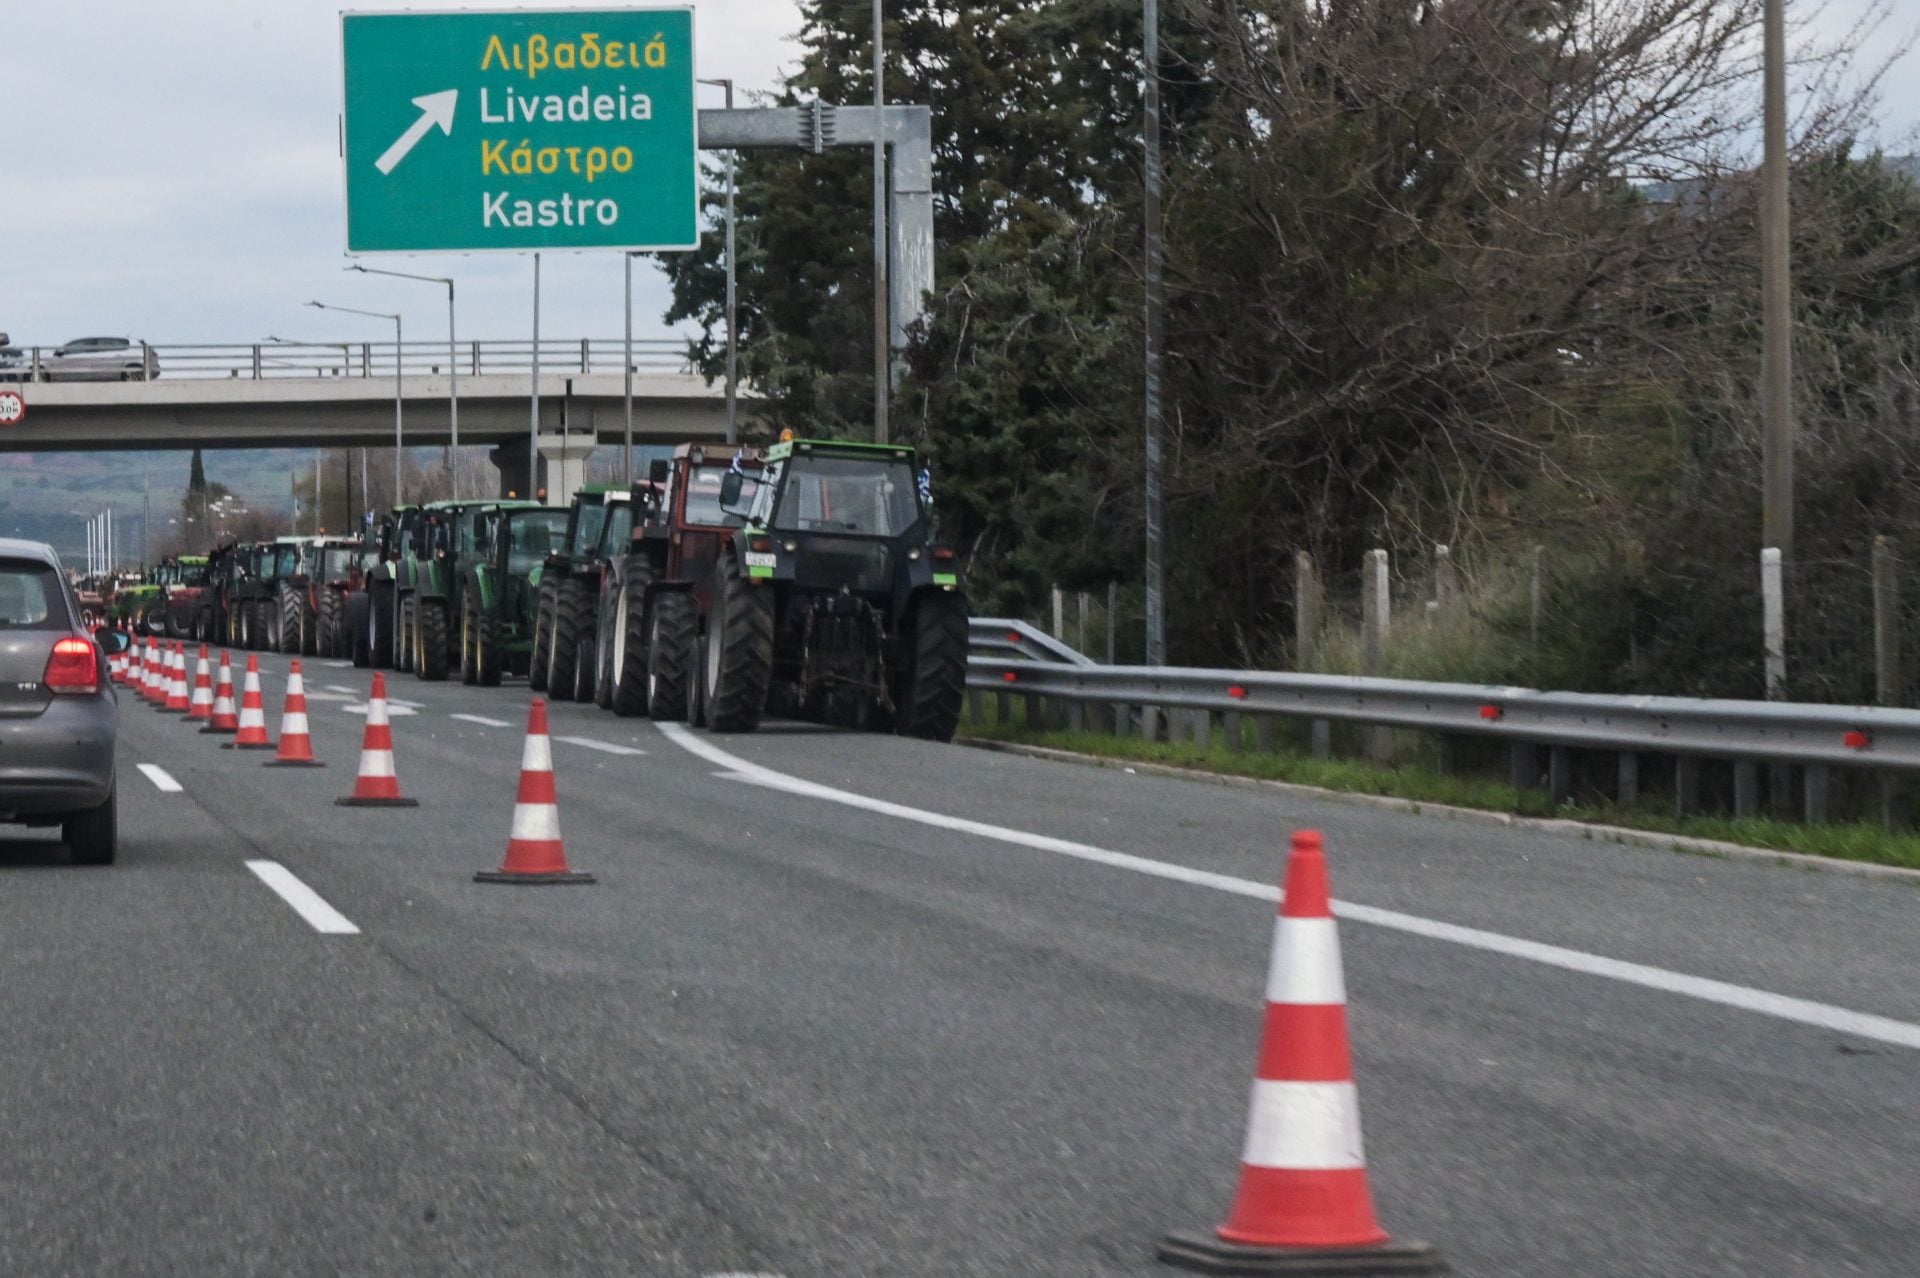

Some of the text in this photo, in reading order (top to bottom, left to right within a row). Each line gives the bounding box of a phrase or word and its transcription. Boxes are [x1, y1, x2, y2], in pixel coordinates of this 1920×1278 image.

[481, 32, 666, 79] Λιβαδειά
[480, 85, 652, 123] Livadeia
[482, 139, 633, 182] Κάστρο
[483, 191, 619, 228] Kastro
